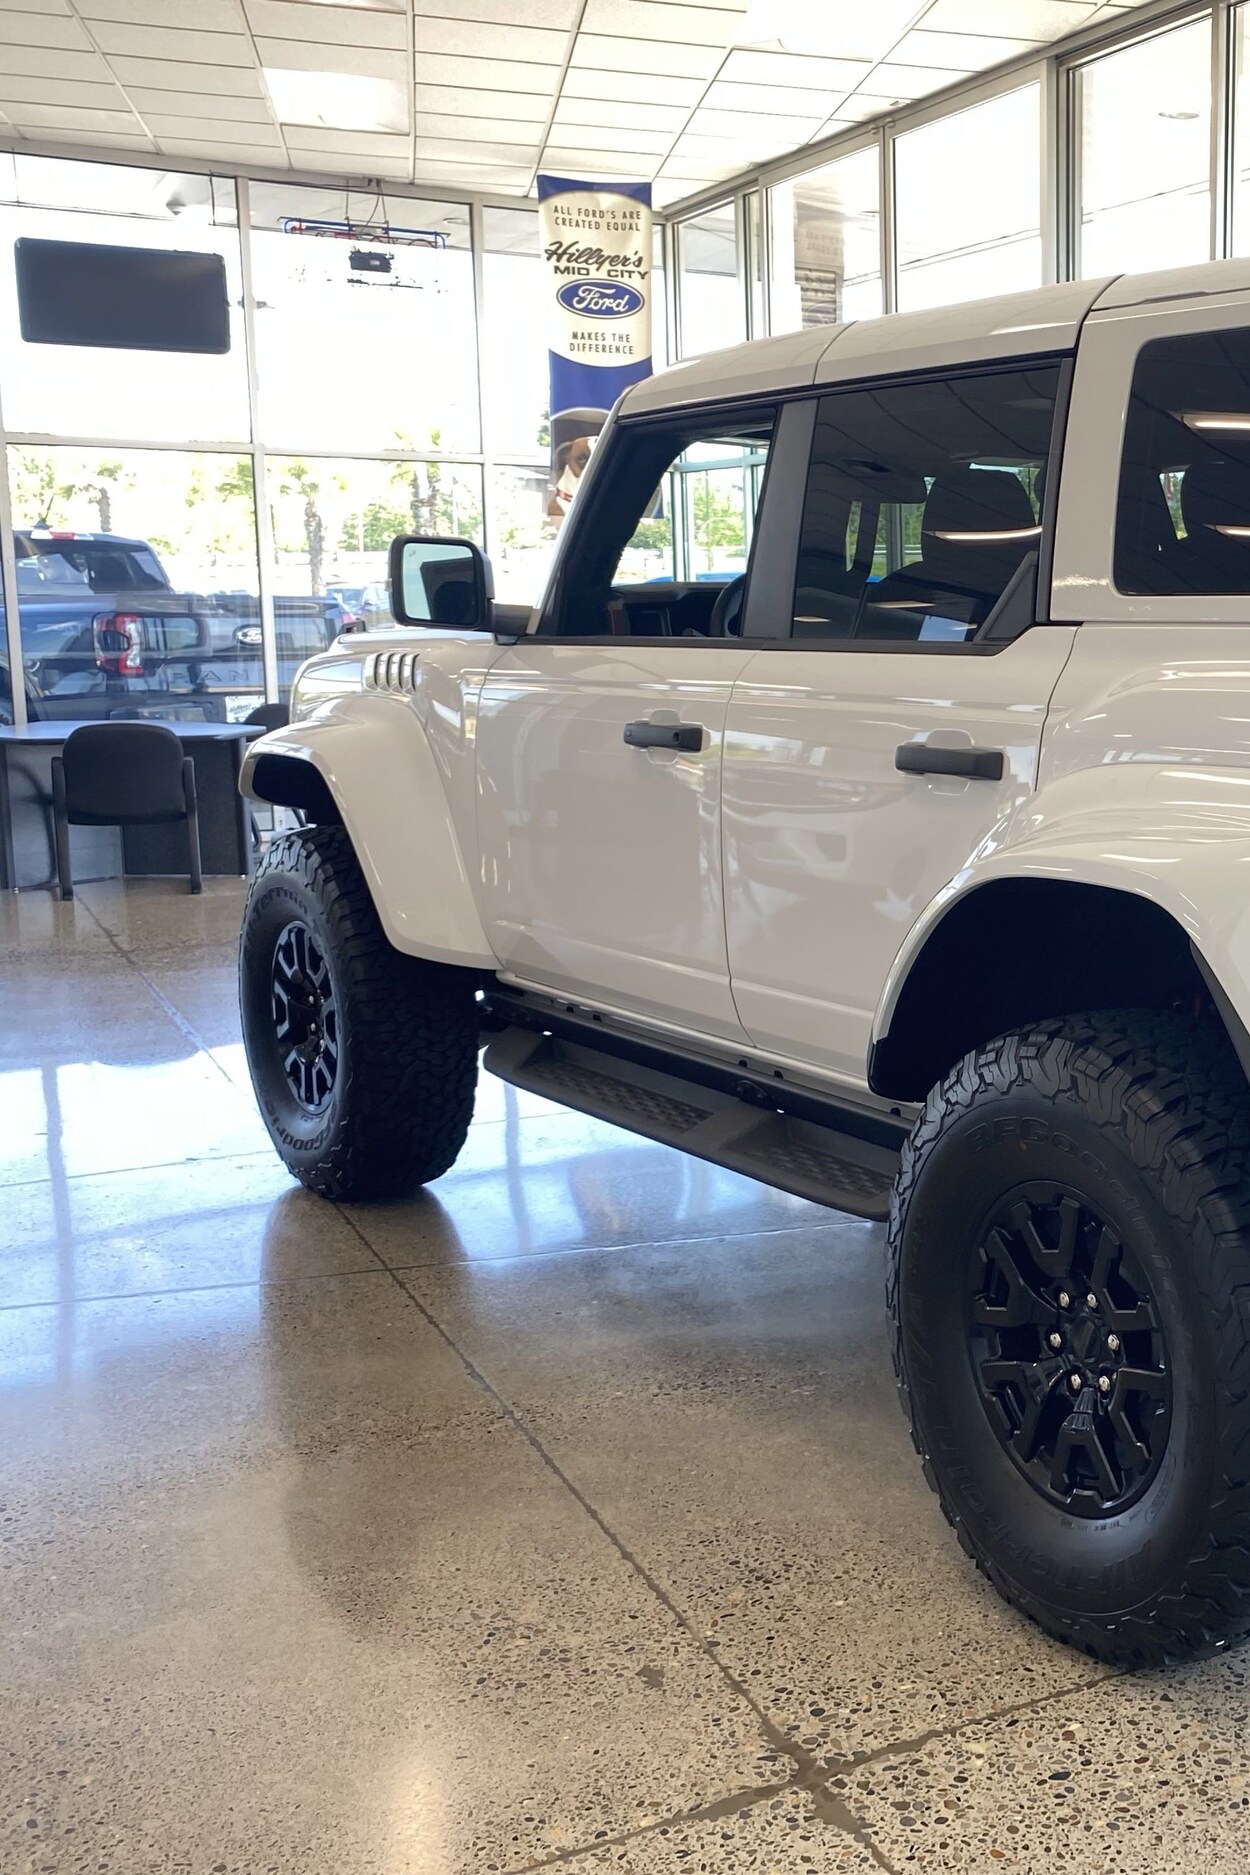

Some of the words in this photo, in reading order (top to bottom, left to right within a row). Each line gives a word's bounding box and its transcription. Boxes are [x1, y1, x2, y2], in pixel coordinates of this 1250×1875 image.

[553, 205, 574, 216] ALL
[578, 208, 617, 220] FORD'S
[622, 210, 641, 220] ARE
[555, 217, 600, 230] CREATED
[606, 220, 641, 232] EQUAL
[544, 240, 643, 272] Hillyer's
[554, 265, 590, 276] MID
[607, 269, 649, 280] CITY
[568, 284, 633, 314] Ford
[571, 331, 606, 342] MAKES
[611, 332, 631, 343] THE
[569, 343, 634, 355] DIFFERENCE
